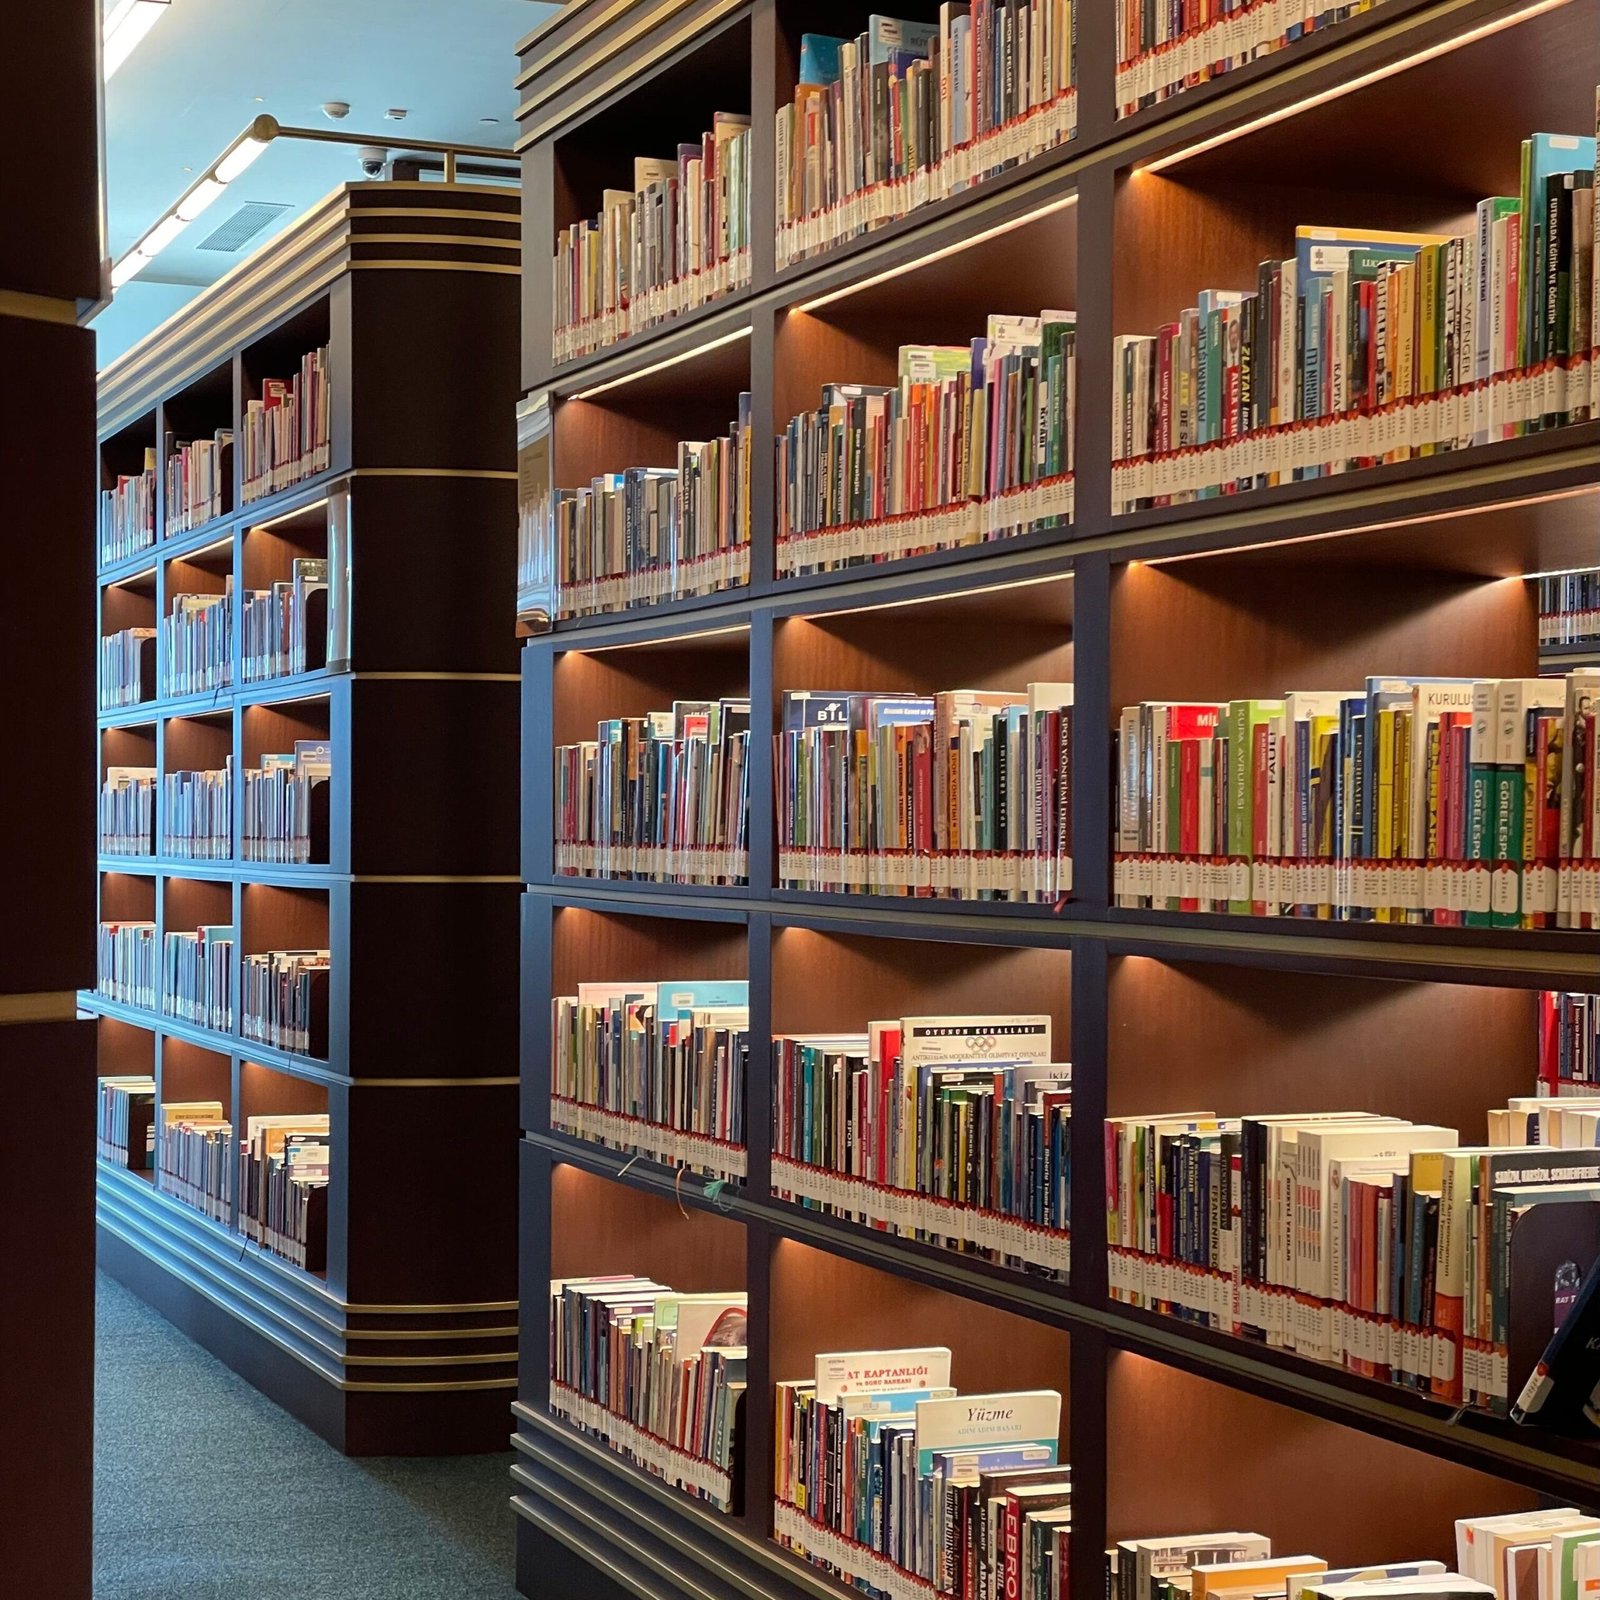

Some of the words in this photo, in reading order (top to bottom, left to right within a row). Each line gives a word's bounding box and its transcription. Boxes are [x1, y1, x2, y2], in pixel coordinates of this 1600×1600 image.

[1549, 197, 1558, 240] FUTBOLDA
[1549, 243, 1558, 271] EĞİTİM
[1549, 273, 1556, 285] VE
[1548, 287, 1558, 324] ÖĞRETİM
[1461, 302, 1473, 375] WENGER
[1180, 371, 1189, 406] ALEX
[1198, 326, 1208, 422] ADANMIŞLIK
[1241, 346, 1250, 402] ZLATAN
[1180, 410, 1188, 427] DE
[1242, 407, 1250, 432] İBRA
[1428, 693, 1474, 706] KURULU
[1061, 716, 1069, 746] SPOR
[1237, 709, 1245, 743] KUPA
[951, 753, 959, 776] SPOR
[1060, 748, 1069, 804] YÖNETİMİ
[1237, 747, 1245, 809] AVRUPASI
[951, 778, 959, 821] YÖNETİMİ
[1059, 808, 1067, 850] DERSLE
[1472, 779, 1483, 859] GÖRELESPO
[1498, 780, 1509, 860] GÖRELESPO
[925, 1028, 968, 1036] OYUNUN
[976, 1026, 1035, 1035] KURALLARI
[1211, 1185, 1219, 1251] EFSANENİN
[864, 1366, 929, 1380] KAPTANLIĞI
[967, 1408, 1014, 1422] Yüzme
[997, 1425, 1022, 1434] BAŞARI
[945, 1491, 954, 1516] BIRD
[1006, 1497, 1017, 1599] LEBRO
[997, 1562, 1005, 1590] PHIL
